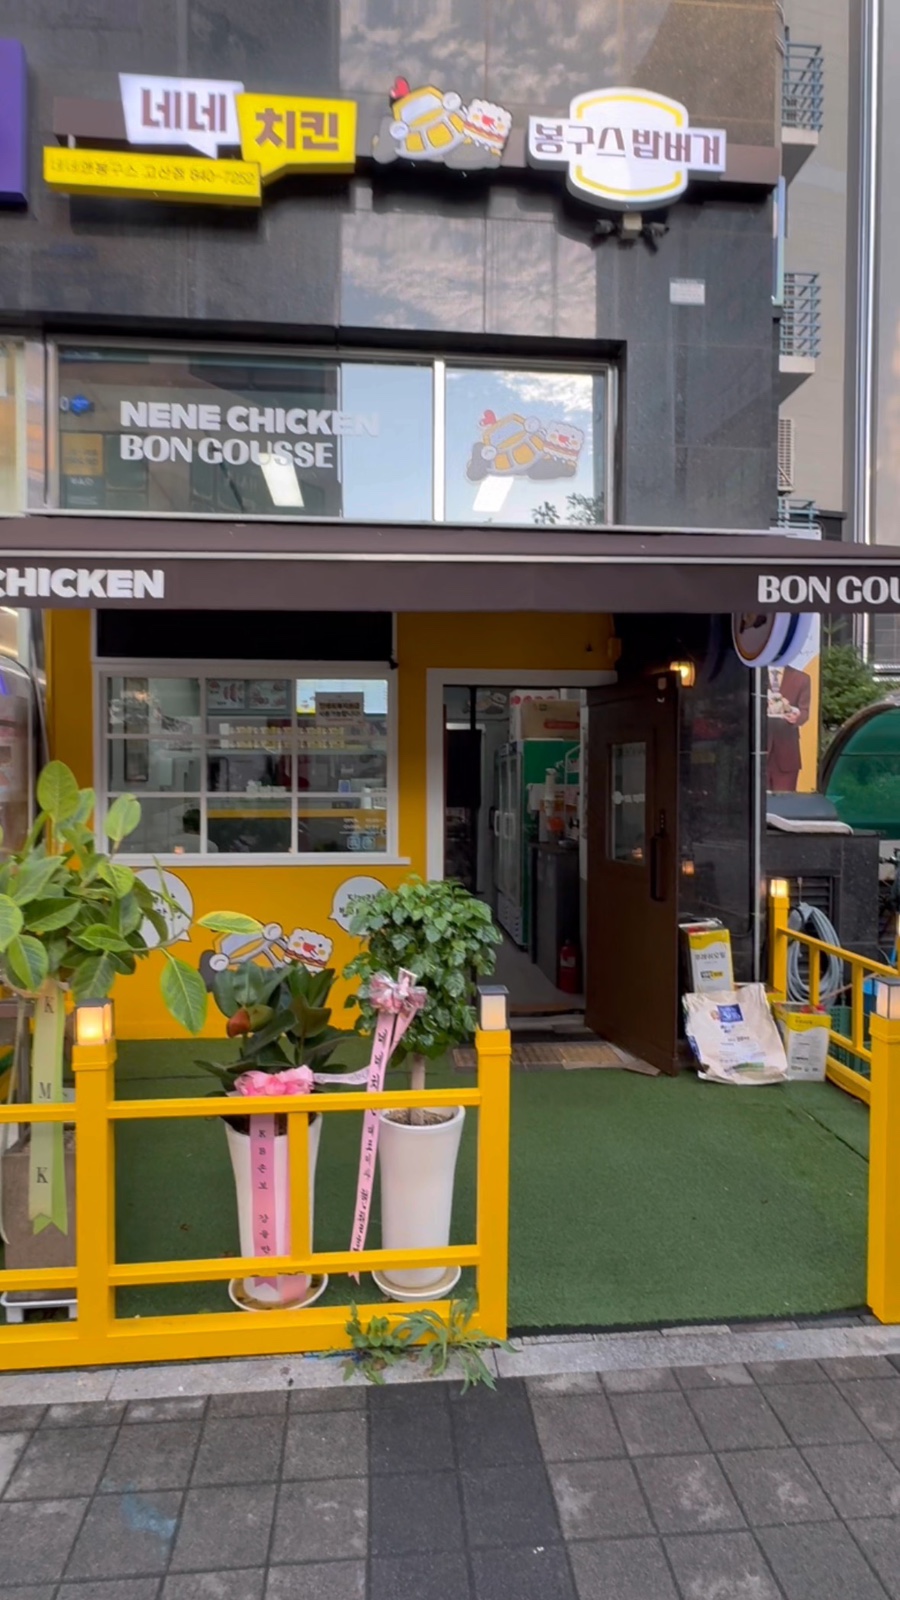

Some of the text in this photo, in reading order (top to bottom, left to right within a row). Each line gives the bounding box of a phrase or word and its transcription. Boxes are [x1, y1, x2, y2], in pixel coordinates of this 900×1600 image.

[141, 87, 339, 152] 네네 치킨
[534, 122, 720, 166] 봉구스밥버거
[120, 401, 380, 438] NENE CHICKEN
[120, 434, 193, 463] BON
[198, 438, 334, 469] GOUSSE
[0, 567, 165, 599] HICKEN
[758, 575, 831, 604] BON
[36, 996, 54, 1184] K M K
